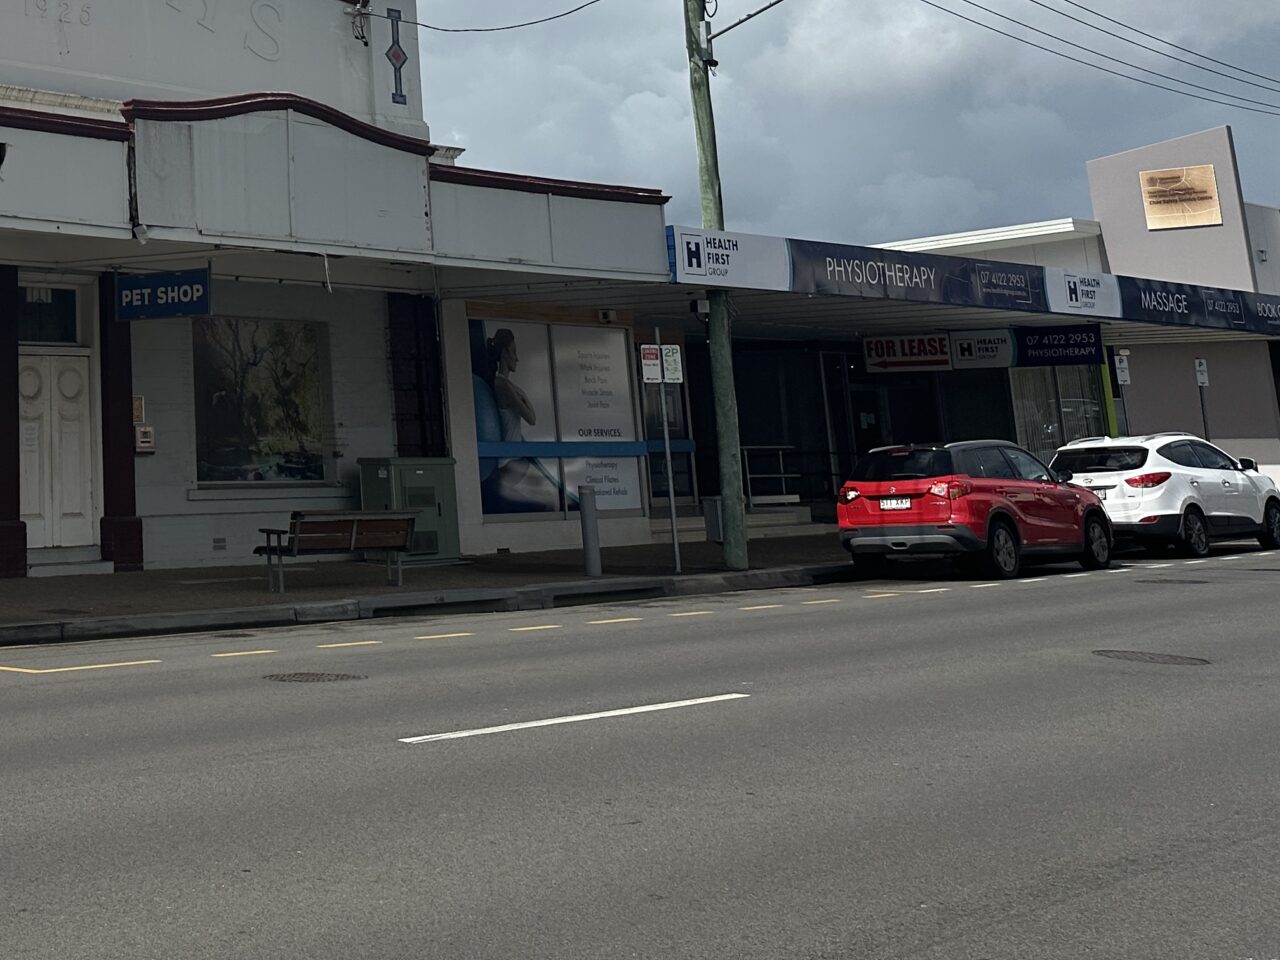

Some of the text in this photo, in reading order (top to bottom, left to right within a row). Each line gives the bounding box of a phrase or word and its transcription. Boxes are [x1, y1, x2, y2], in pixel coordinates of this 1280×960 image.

[705, 237, 739, 252] HEALTH
[707, 252, 730, 266] FIRST
[708, 267, 729, 277] GROUP
[826, 257, 936, 289] PHYSIOTHERAPY
[981, 271, 1026, 287] 07 4122 2953
[1080, 277, 1101, 289] HEALTH
[122, 284, 204, 306] PET SHOP
[1081, 289, 1096, 300] FIRST
[1141, 289, 1189, 314] MASSAGE
[1257, 302, 1278, 319] BOOK
[976, 337, 1008, 346] HEALTH
[1026, 333, 1096, 346] 07 4122 2953
[664, 348, 679, 357] 2P
[866, 336, 948, 358] FOR LEASE
[977, 346, 999, 354] FIRST
[1027, 346, 1096, 358] PHYSIOTHERAPY
[578, 428, 592, 438] OUR
